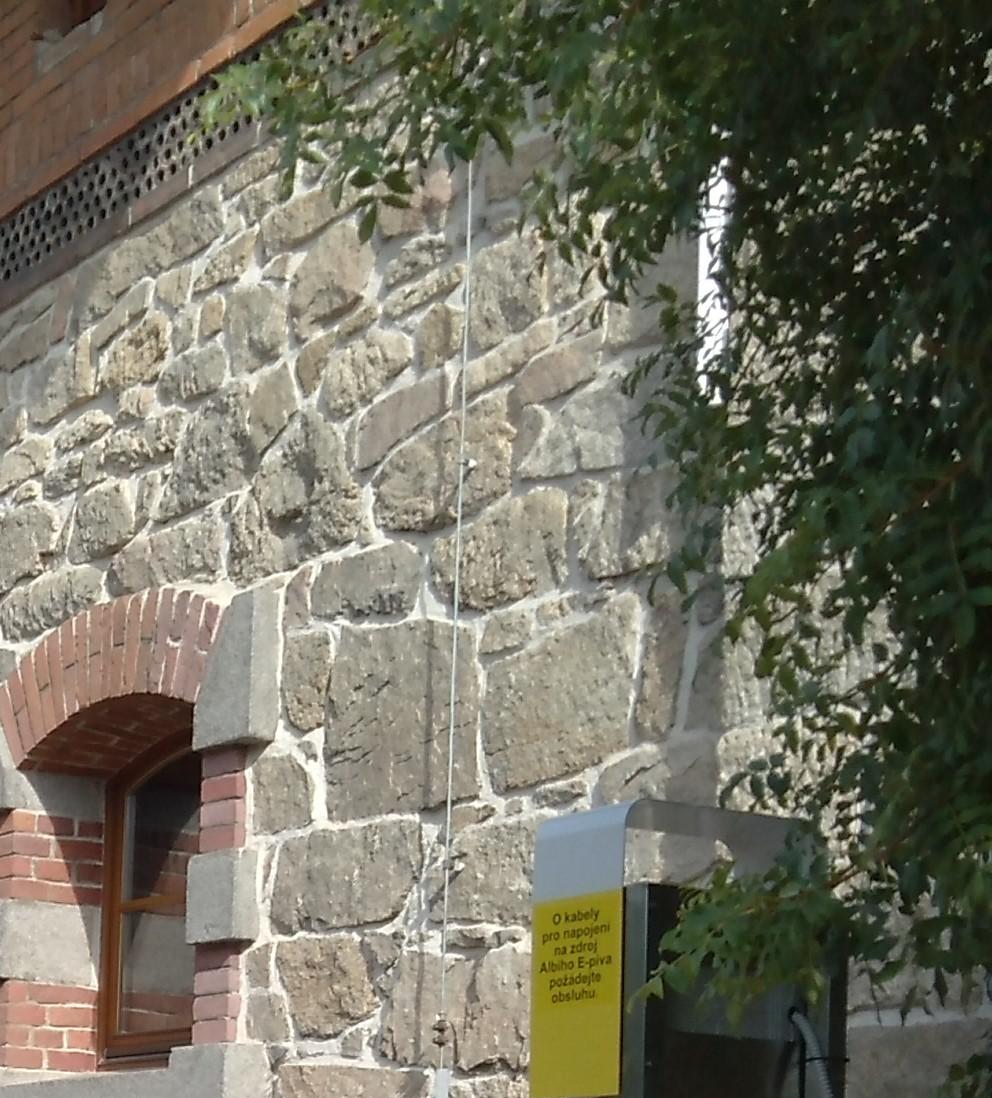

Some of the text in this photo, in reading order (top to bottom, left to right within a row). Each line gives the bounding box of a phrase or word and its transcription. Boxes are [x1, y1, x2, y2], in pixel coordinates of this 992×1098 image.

[552, 908, 600, 926] O kabely
[542, 931, 560, 945] pro
[554, 940, 598, 956] na zdroj
